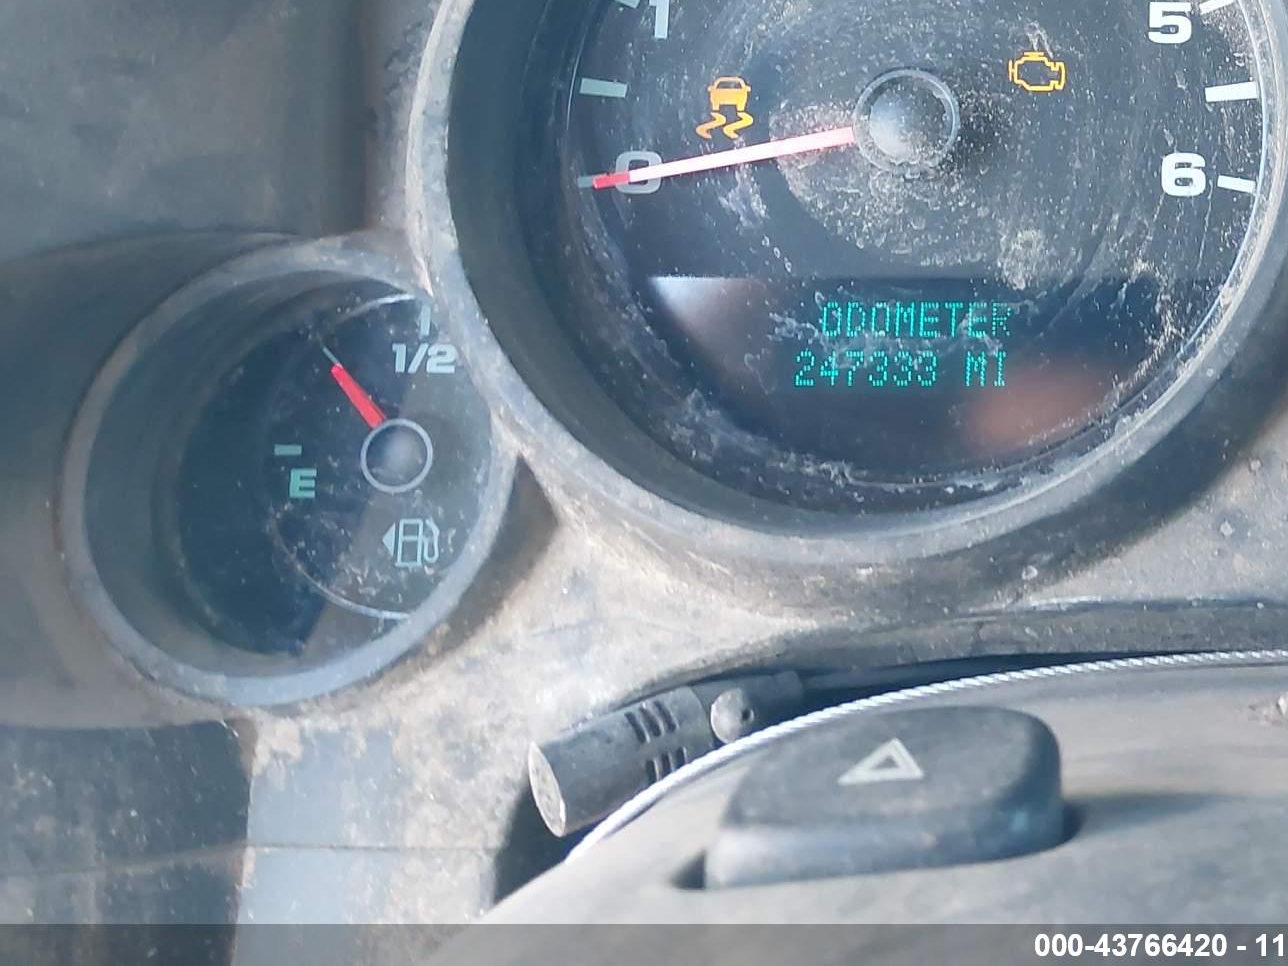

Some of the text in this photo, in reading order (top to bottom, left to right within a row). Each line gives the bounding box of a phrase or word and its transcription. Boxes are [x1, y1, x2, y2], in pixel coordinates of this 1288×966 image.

[1147, 1, 1193, 44] 5
[615, 150, 663, 195] 0
[1160, 152, 1206, 197] 6
[822, 301, 1012, 338] ODOMETER
[392, 343, 457, 374] 1/2
[795, 349, 1007, 387] 247333 MI
[289, 468, 318, 499] E
